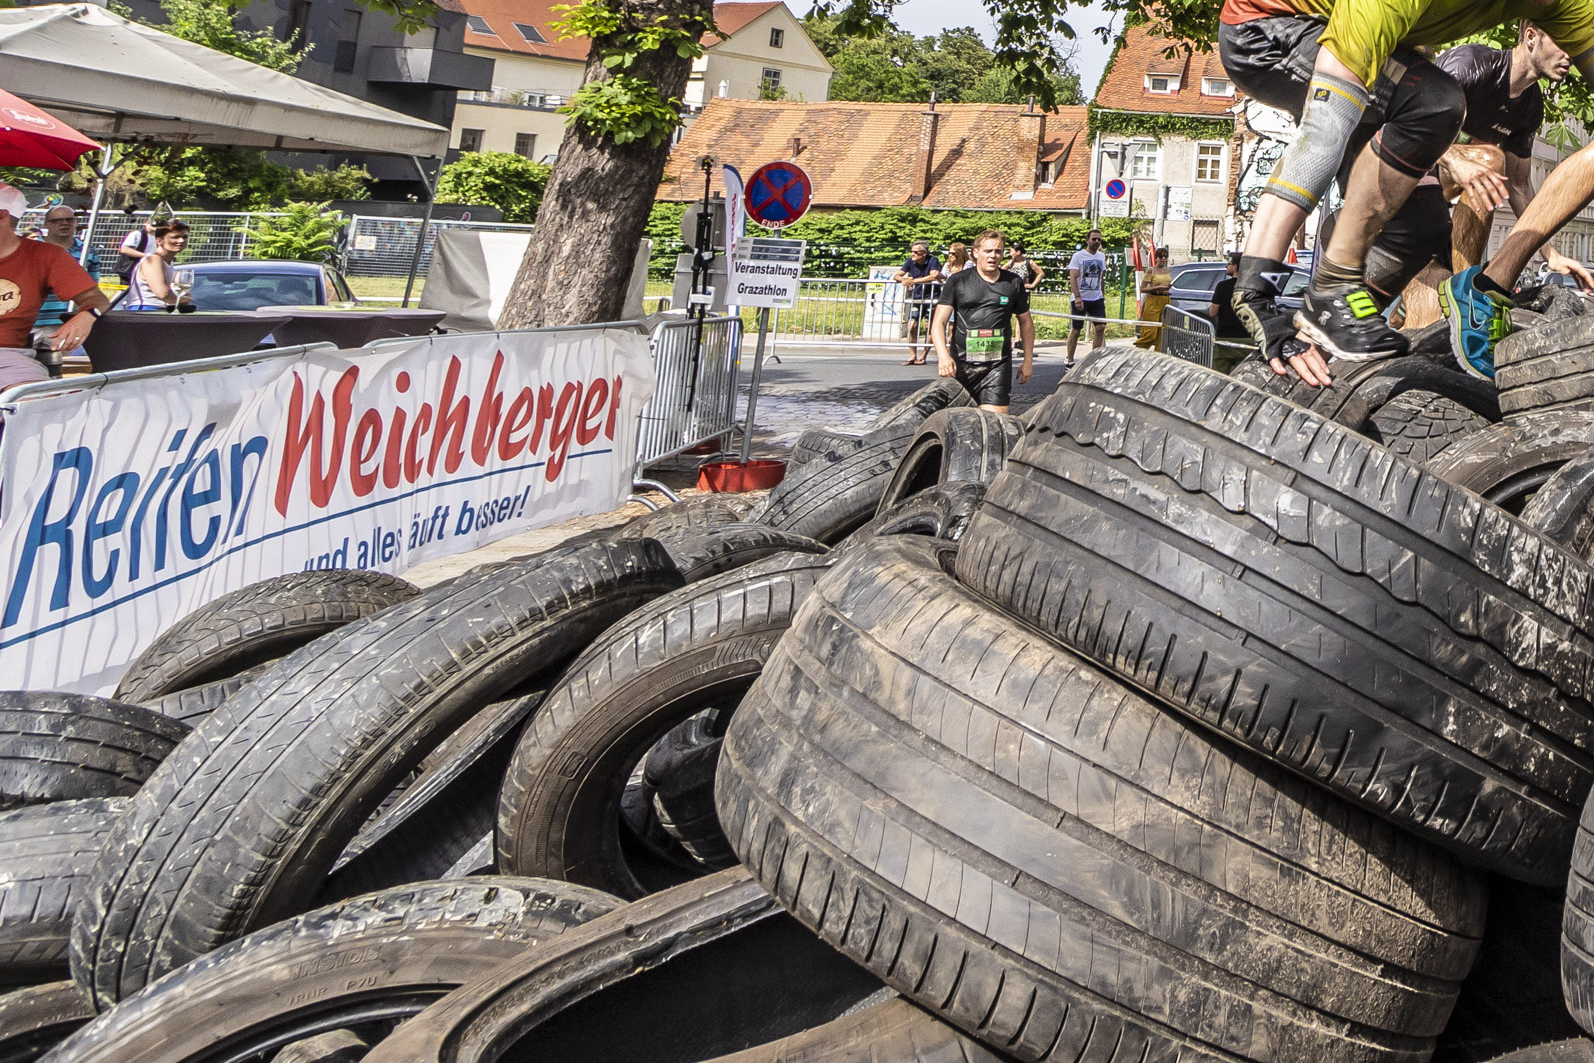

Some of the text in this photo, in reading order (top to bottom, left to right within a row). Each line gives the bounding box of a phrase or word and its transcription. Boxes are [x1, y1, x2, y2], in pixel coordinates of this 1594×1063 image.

[761, 219, 785, 228] ENDE
[735, 262, 799, 279] Veranstaltung
[737, 283, 787, 296] Grazathlon
[1, 349, 623, 628] Reifen Weichberger
[357, 526, 402, 570] alles
[408, 504, 451, 552] äuft
[454, 484, 532, 537] besser!
